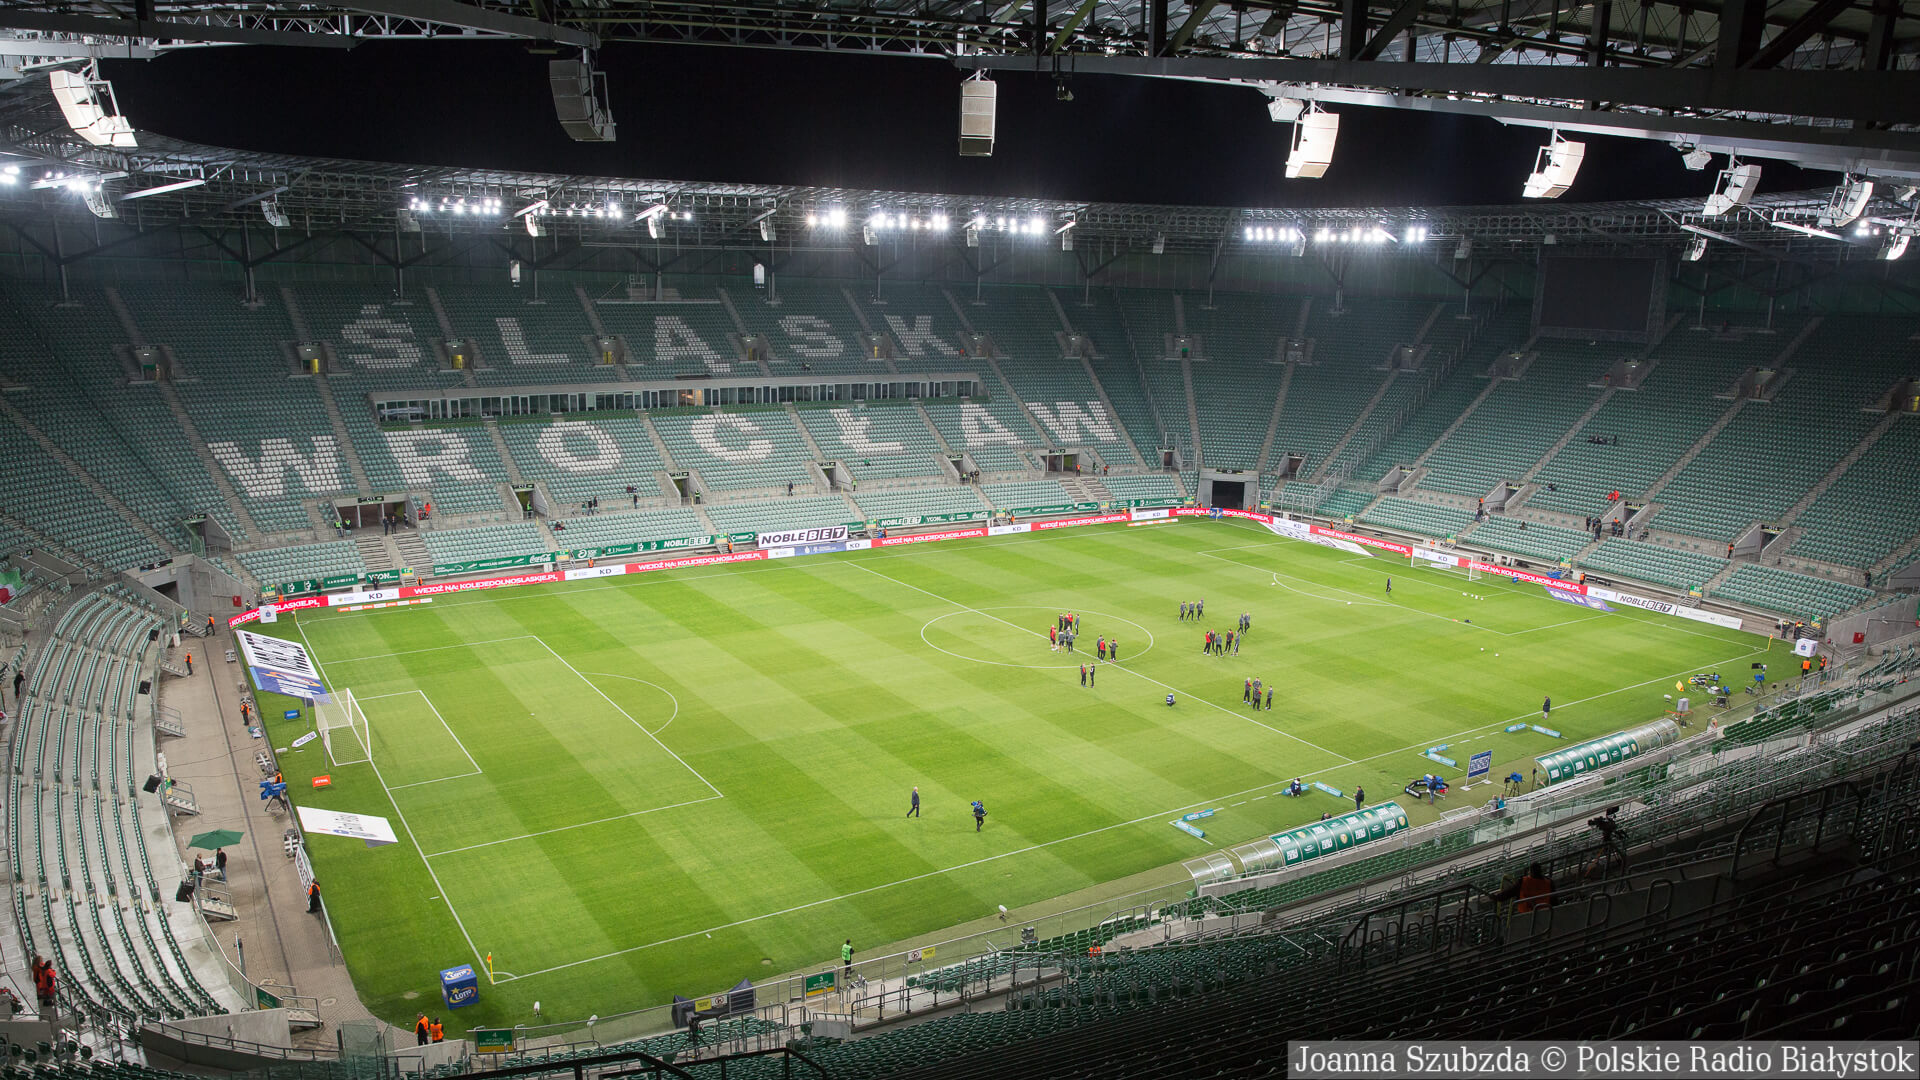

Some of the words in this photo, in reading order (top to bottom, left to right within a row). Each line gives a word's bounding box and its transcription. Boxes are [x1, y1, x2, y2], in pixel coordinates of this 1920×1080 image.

[340, 303, 960, 374] ŚLĄSK
[206, 401, 1119, 499] WROCŁAW
[663, 535, 712, 548] NOBLEBET
[761, 526, 846, 545] NOBLEBET
[368, 592, 383, 600] KD
[414, 585, 443, 595] WEJDŹ
[445, 583, 459, 592] NA:
[1619, 595, 1673, 613] NOBLEBET
[454, 989, 472, 1000] LOTTO
